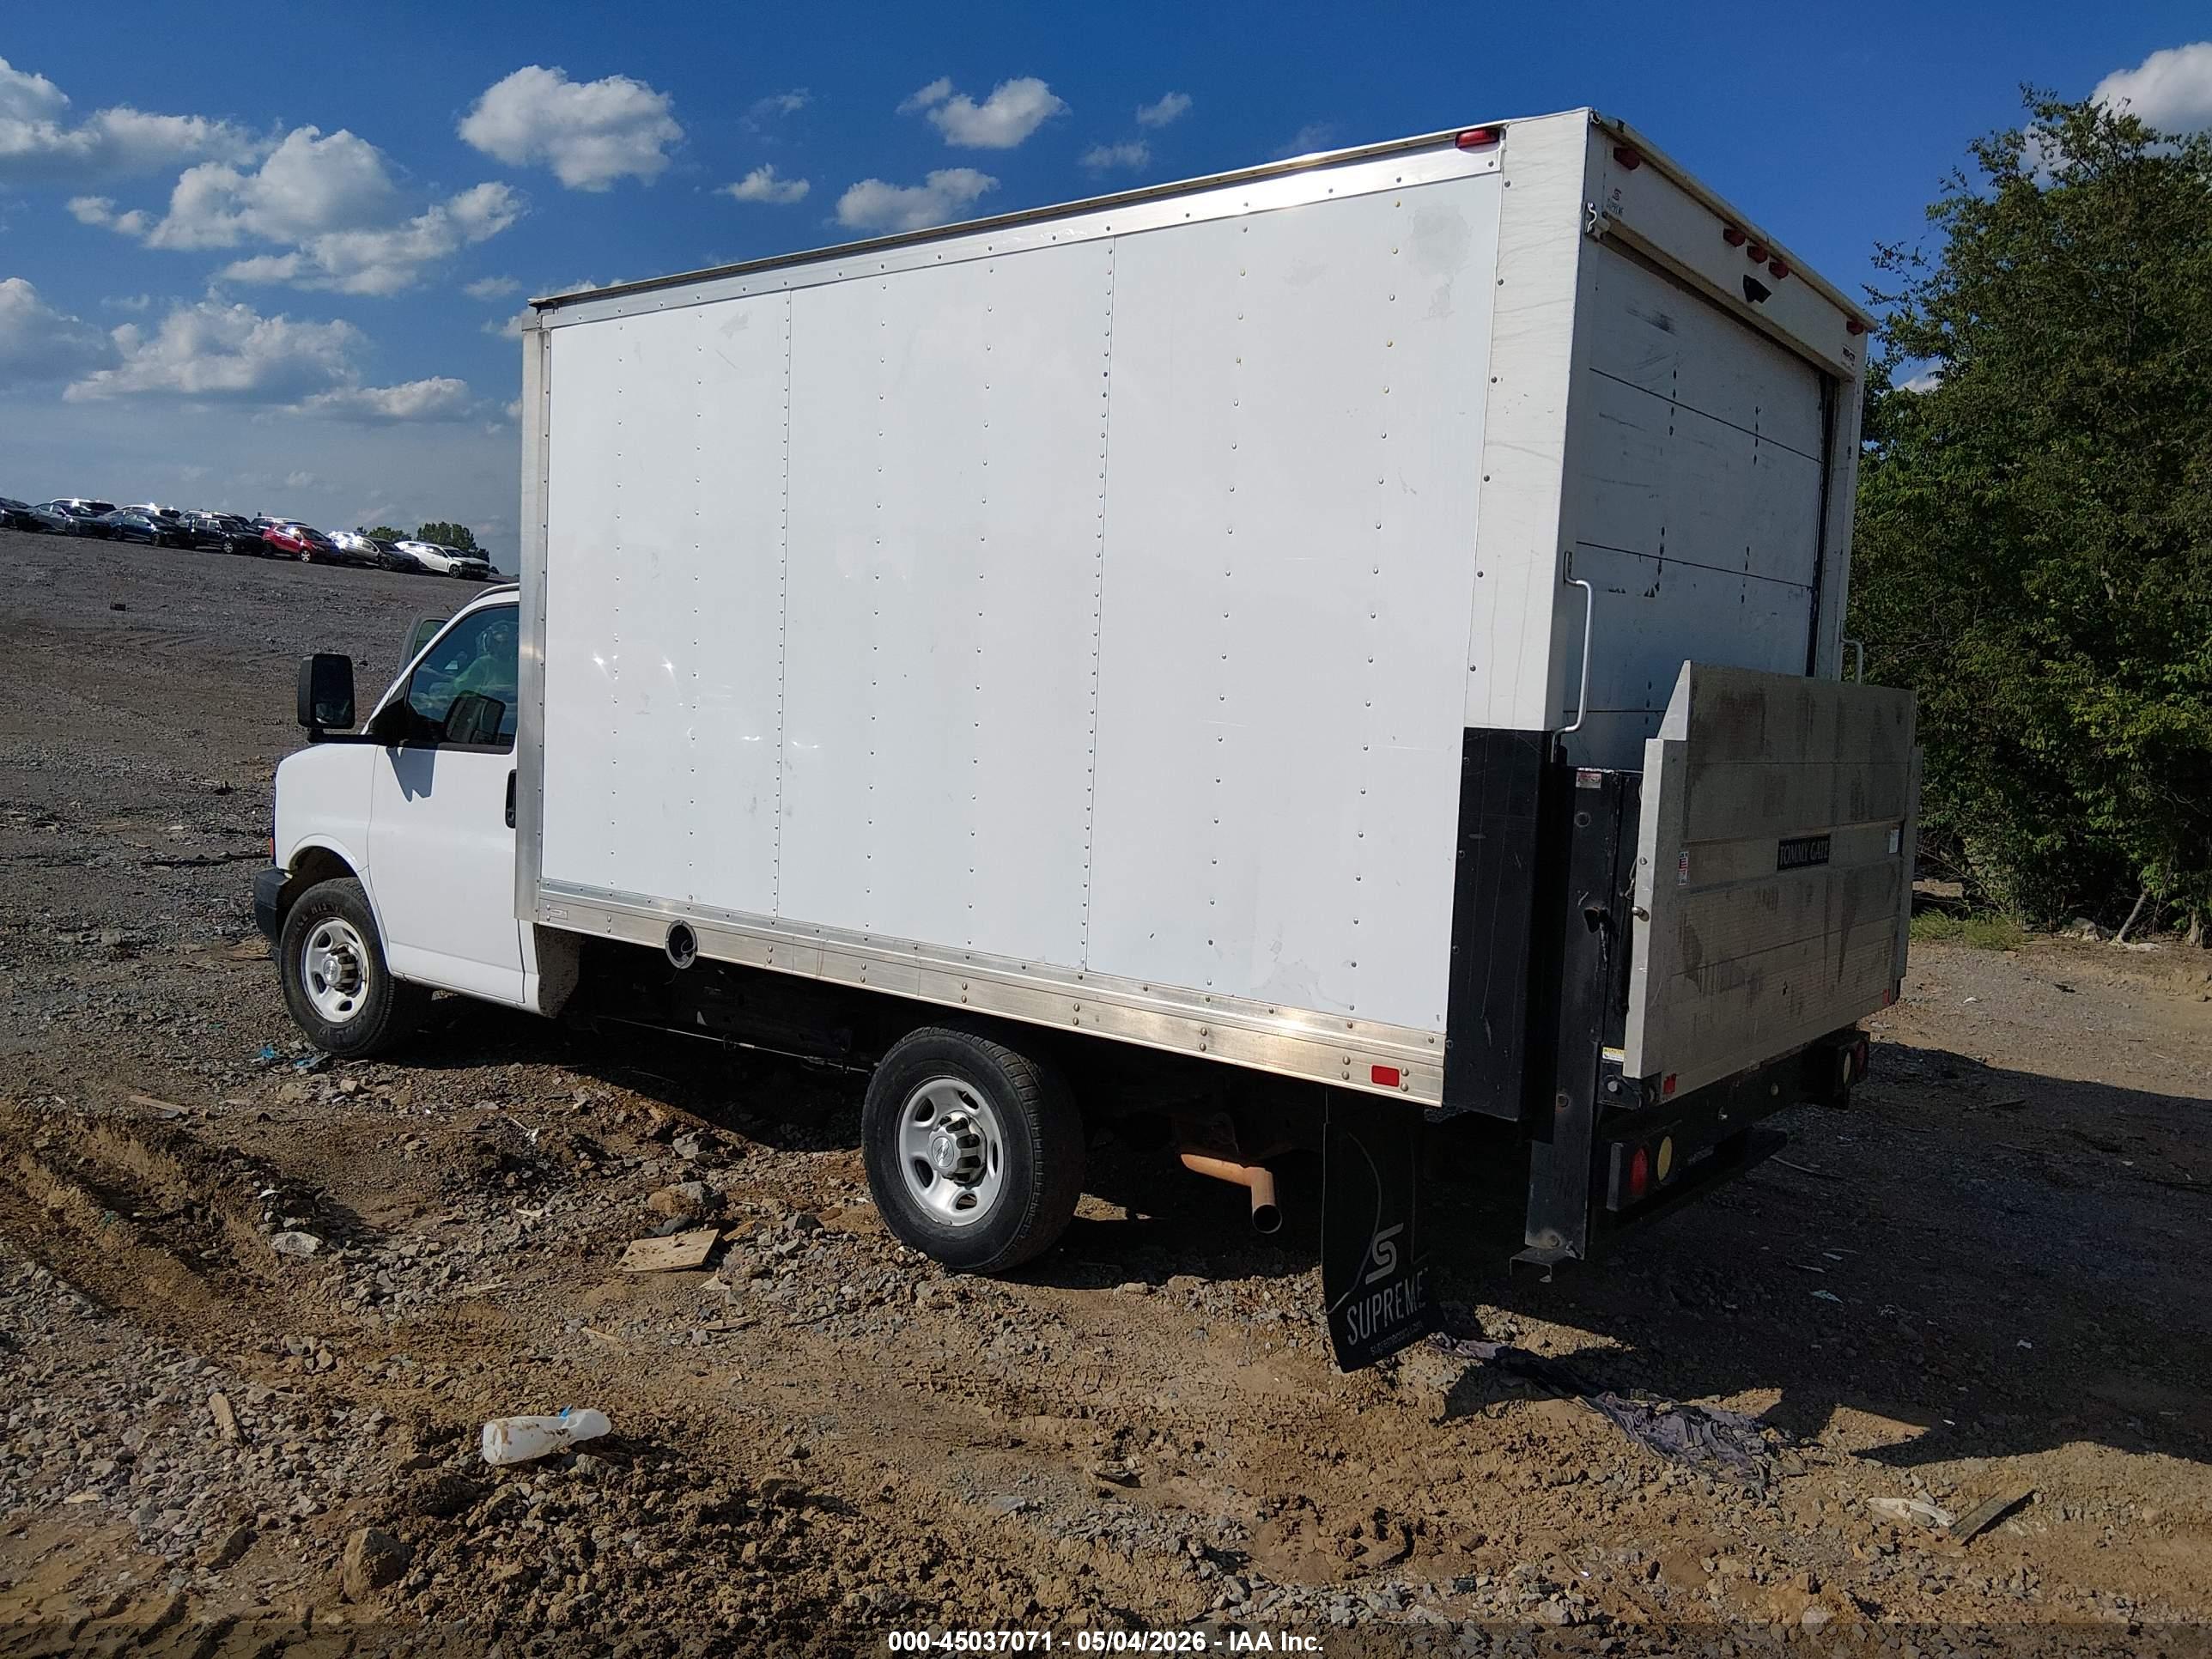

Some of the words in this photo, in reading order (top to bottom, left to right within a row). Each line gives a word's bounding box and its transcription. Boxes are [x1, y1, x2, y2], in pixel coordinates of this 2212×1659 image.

[1780, 842, 1809, 866] TOMMY
[1809, 841, 1829, 861] GATE
[1346, 1269, 1424, 1346] SUPREME
